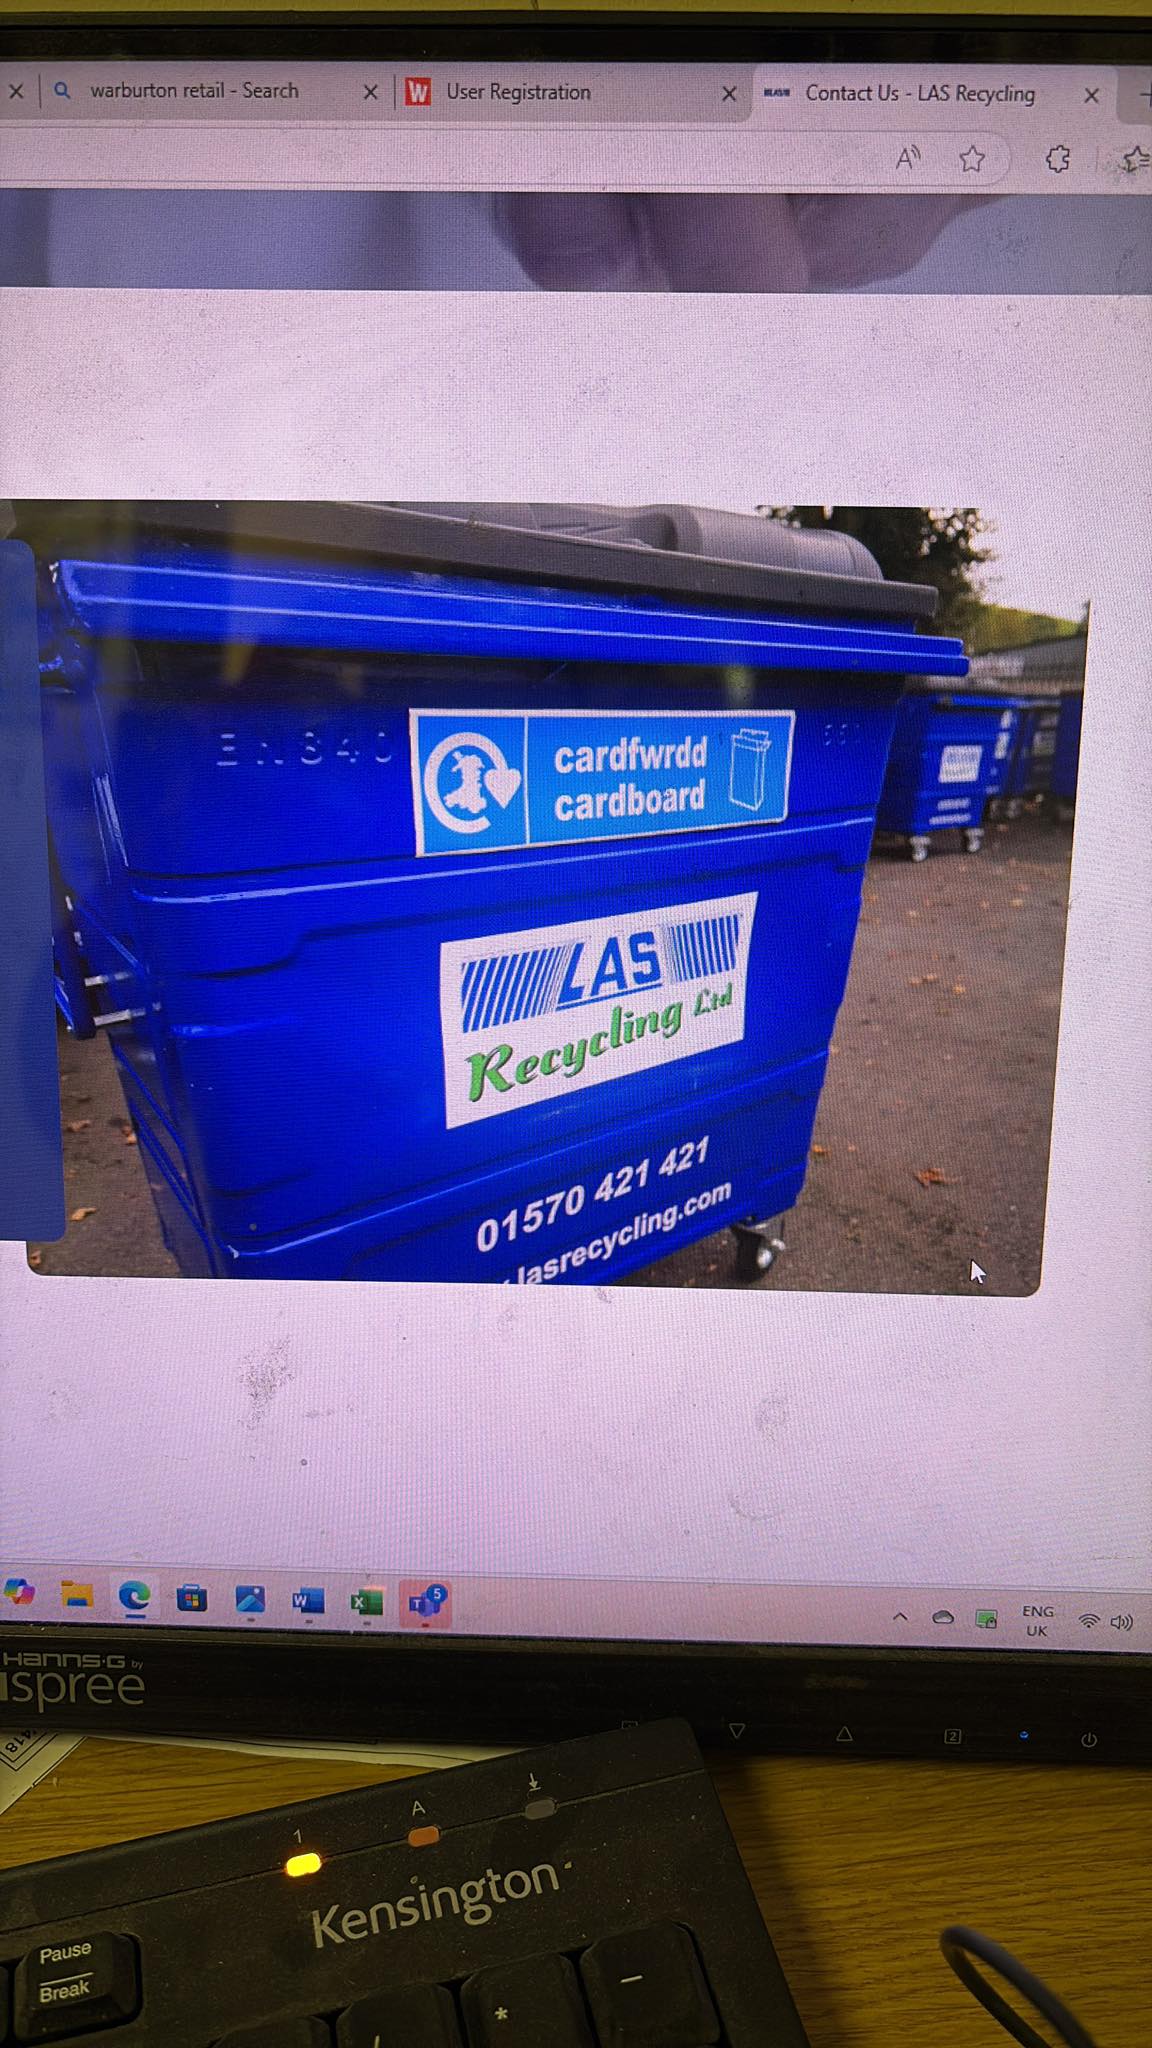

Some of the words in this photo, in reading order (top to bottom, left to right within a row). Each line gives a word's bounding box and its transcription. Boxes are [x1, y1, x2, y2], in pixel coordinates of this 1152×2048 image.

[90, 82, 177, 99] warburton
[183, 82, 225, 98] retail
[243, 82, 299, 99] Search
[447, 83, 485, 101] User
[490, 83, 591, 103] Registration
[806, 84, 873, 102] Contact
[878, 85, 899, 102] Us
[918, 85, 950, 102] LAS
[956, 85, 1036, 107] Recycling
[555, 736, 708, 775] cardfwrdd
[554, 779, 706, 822] cardboard
[557, 930, 662, 1004] LAS
[465, 1001, 683, 1102] Recycling
[693, 982, 733, 1016] Ltd
[477, 1185, 585, 1253] 01570
[594, 1158, 650, 1202] 421
[658, 1135, 710, 1177] 421
[503, 1182, 732, 1285] lasrecycling.com
[1022, 1605, 1054, 1618] ENG
[1026, 1624, 1047, 1638] UK
[131, 1659, 144, 1670] by
[411, 1800, 426, 1816] A
[312, 1862, 559, 1948] Kensington
[40, 1943, 92, 1965] Pause
[40, 1980, 90, 2003] Break
